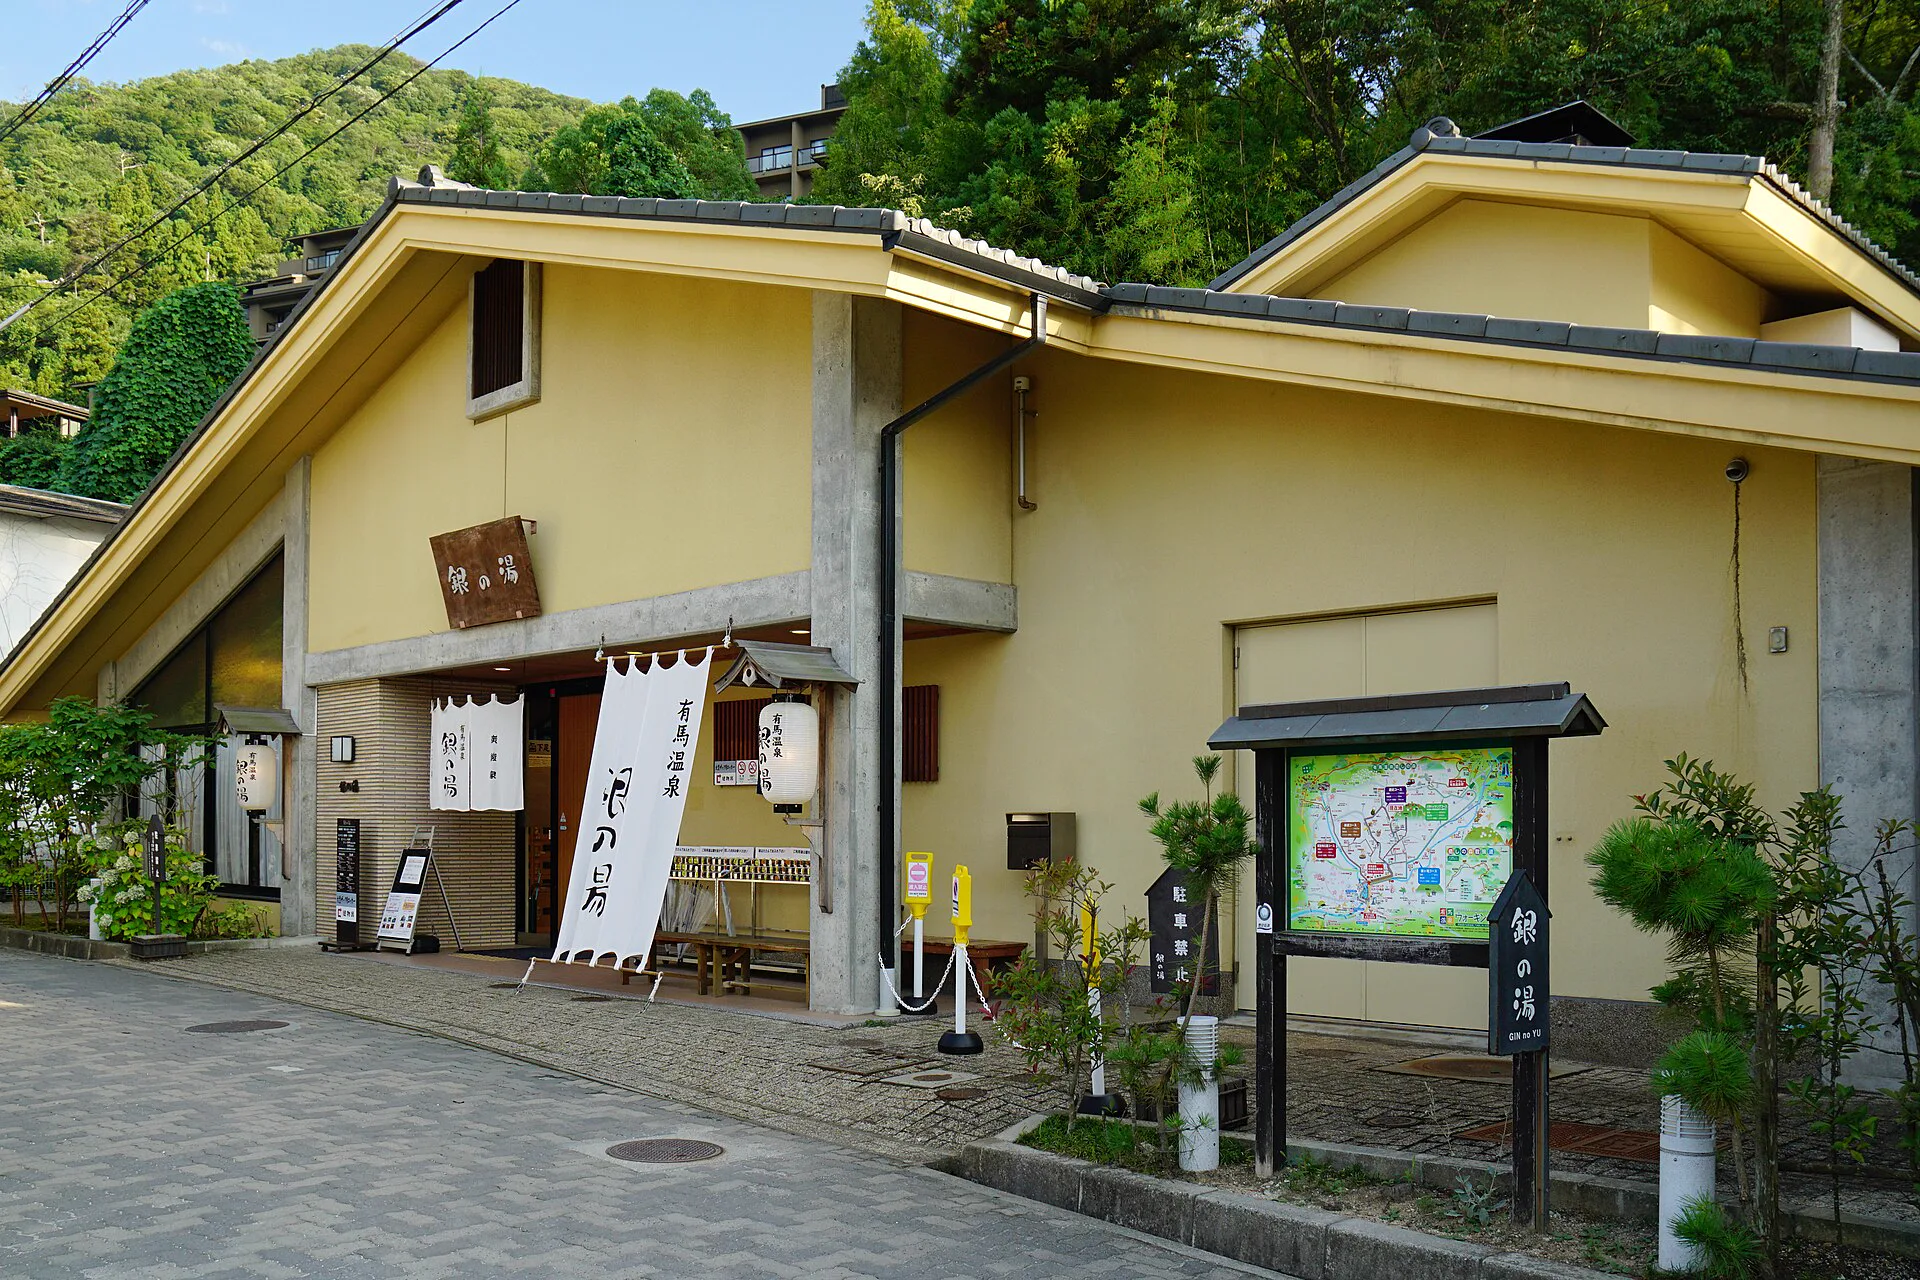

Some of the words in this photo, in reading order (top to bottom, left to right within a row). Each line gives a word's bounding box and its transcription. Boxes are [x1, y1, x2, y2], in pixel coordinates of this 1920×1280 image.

[448, 554, 519, 595] 銀の湯
[662, 698, 694, 799] 有馬温泉
[771, 713, 783, 758] 有馬温泉
[236, 759, 249, 803] 銀の湯
[249, 752, 257, 781] 有馬温泉
[441, 732, 458, 798] 銀の湯
[1173, 886, 1189, 982] 駐車禁止
[1155, 953, 1165, 980] 銀の湯
[1511, 906, 1537, 1021] 銀の湯
[1508, 1031, 1521, 1041] GIN
[1532, 1029, 1542, 1038] YU
